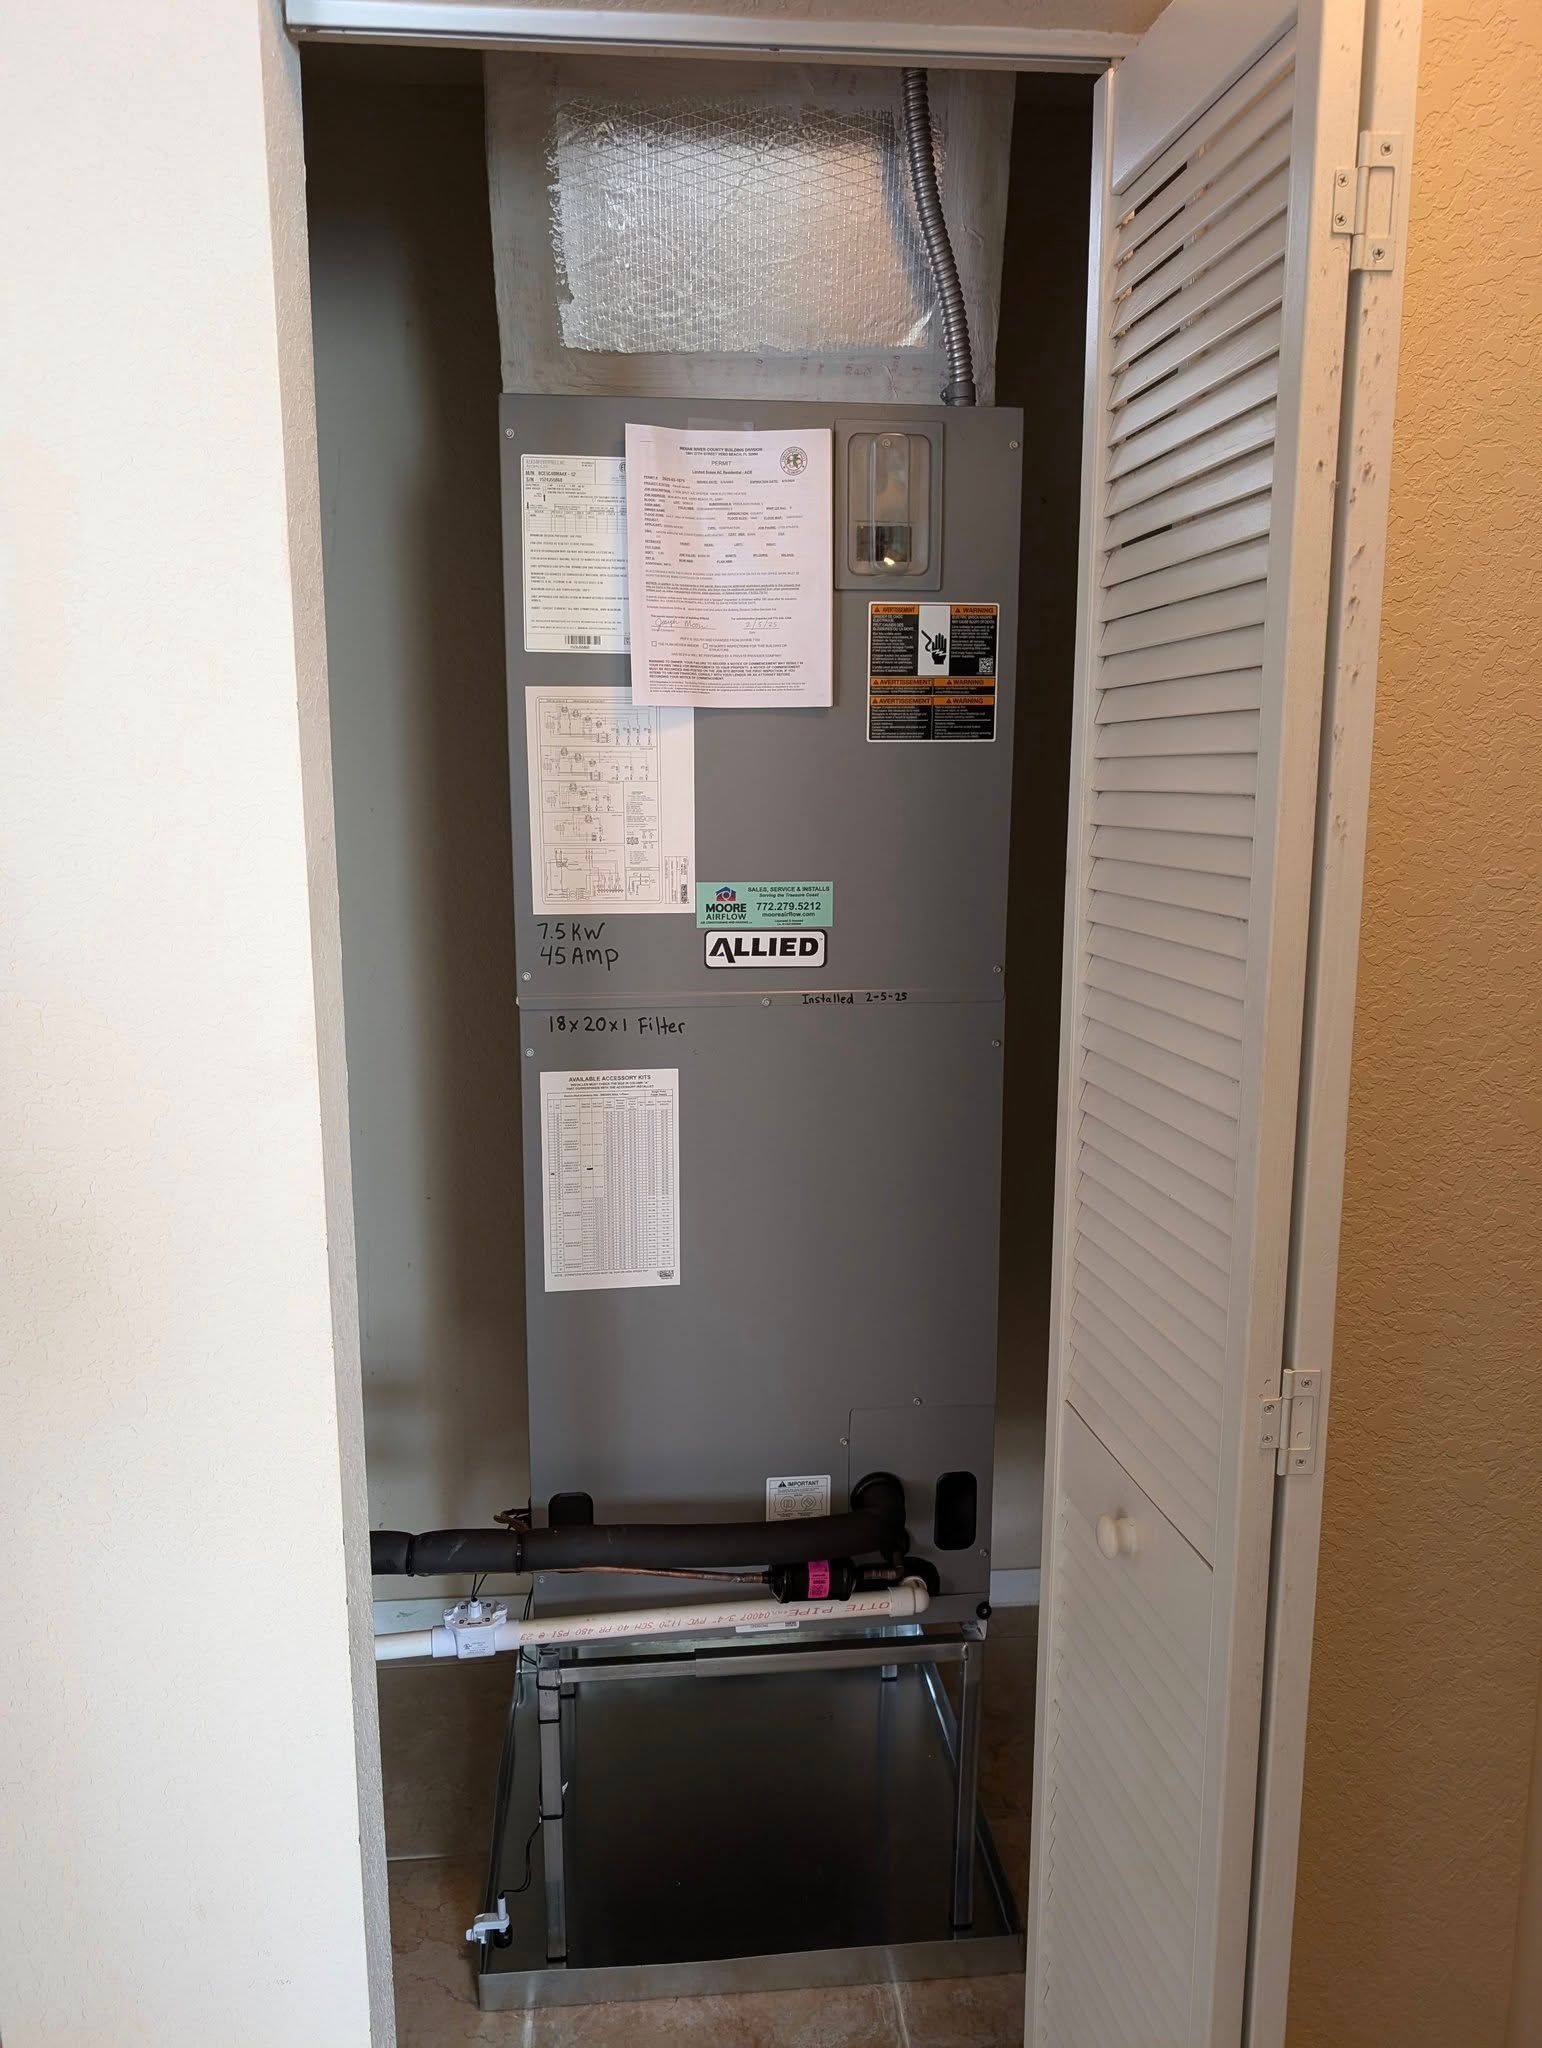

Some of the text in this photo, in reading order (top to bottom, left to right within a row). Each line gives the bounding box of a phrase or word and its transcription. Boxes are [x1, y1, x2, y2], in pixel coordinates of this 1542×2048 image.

[745, 618, 779, 630] 2/5/25
[706, 904, 746, 912] MOORE
[756, 902, 821, 910] 772.279.5212
[537, 923, 566, 940] 7.5
[708, 937, 819, 963] ALLIED
[540, 946, 619, 971] 45 Amp
[802, 992, 908, 1004] Installed 2-5-25
[638, 1016, 686, 1035] Filter
[786, 1606, 834, 1617] PIPE
[687, 1617, 706, 1625] PVC
[598, 1626, 613, 1634] PR
[635, 1622, 653, 1630] SCH
[551, 1630, 570, 1638] PSI
[576, 1628, 594, 1636] 480
